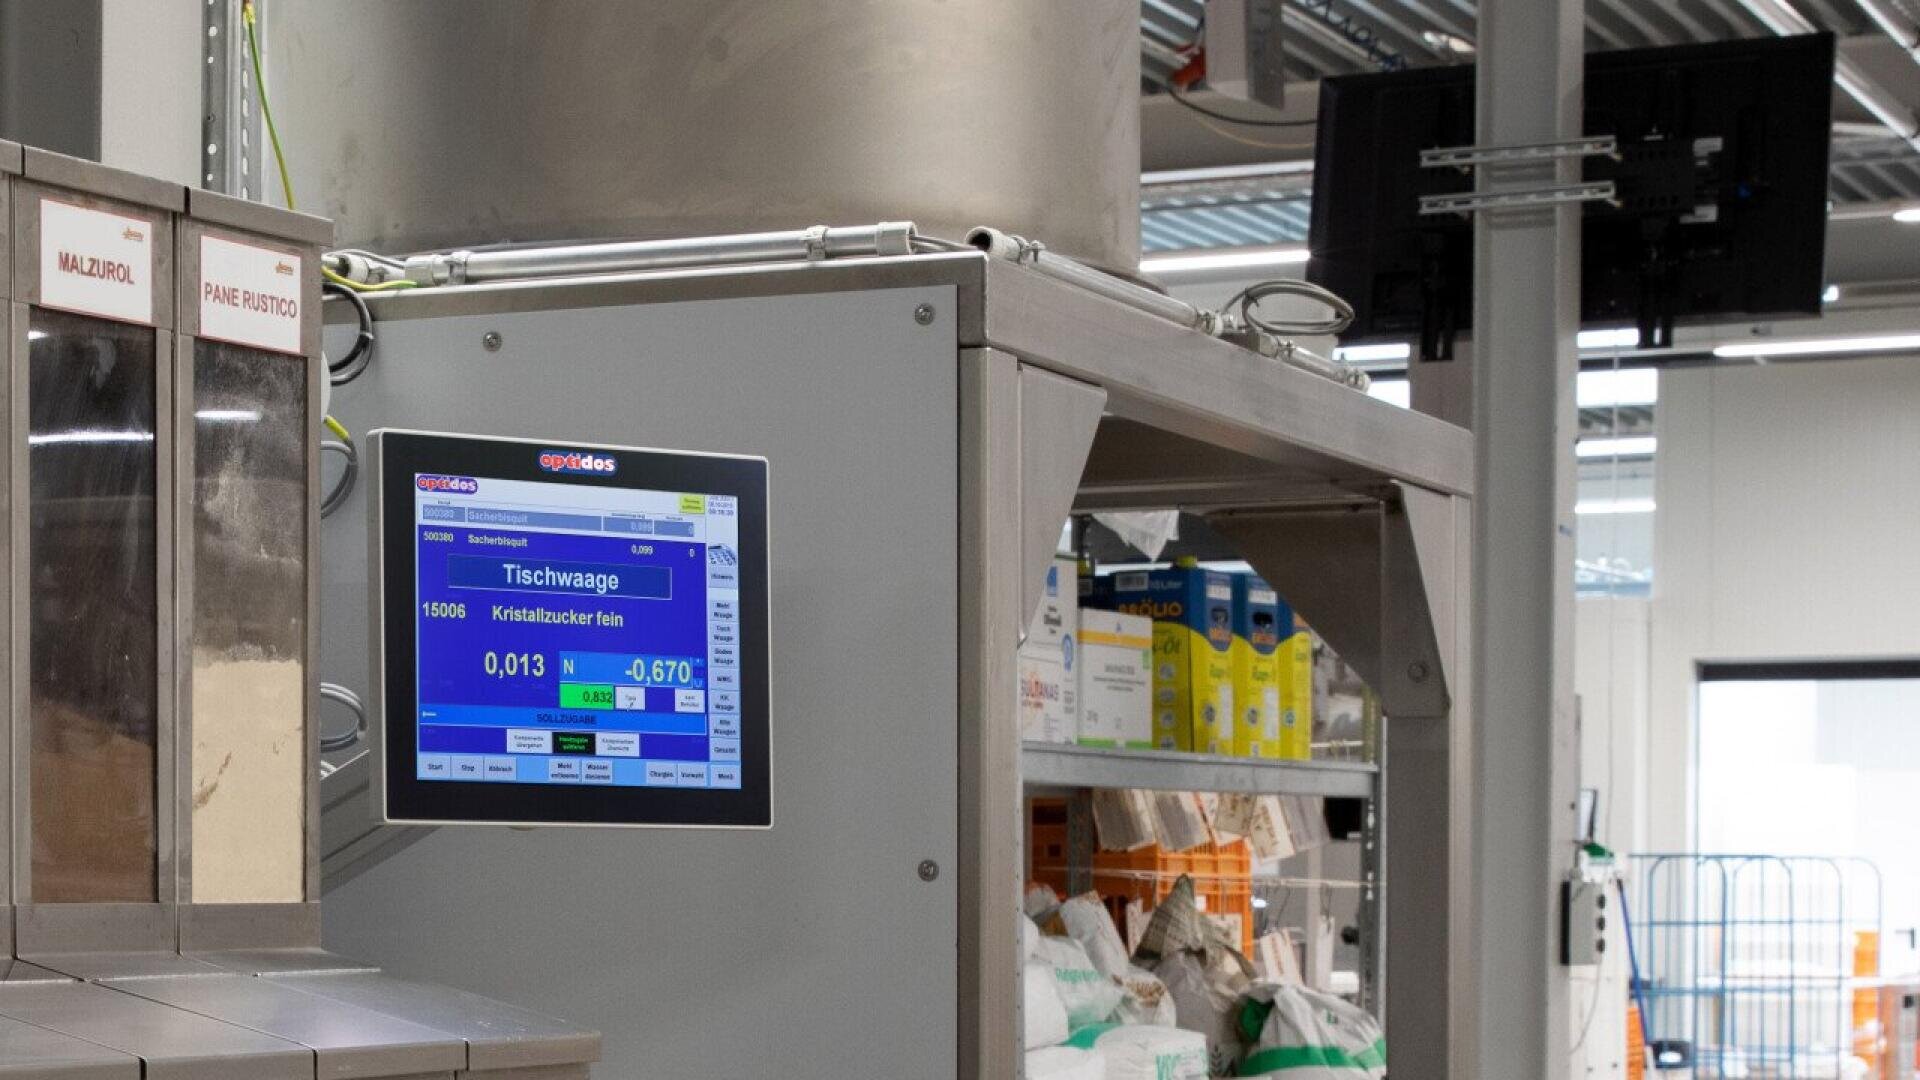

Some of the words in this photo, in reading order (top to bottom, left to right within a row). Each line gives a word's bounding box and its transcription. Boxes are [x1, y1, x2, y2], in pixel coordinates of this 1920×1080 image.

[58, 251, 135, 285] MALZUROL
[204, 281, 240, 307] PANE
[242, 290, 298, 319] RUSTICO
[539, 453, 616, 472] optidos
[417, 477, 477, 493] optidos
[467, 533, 528, 548] Sacherbisquit
[631, 543, 654, 556] 0,099
[502, 563, 619, 595] Tischwaage
[422, 601, 466, 619] 15006
[492, 604, 593, 625] Kristallzucker
[596, 610, 624, 628] fein
[484, 650, 546, 679] 0,013
[563, 658, 574, 675] N
[624, 657, 692, 685] -0,670
[583, 690, 613, 705] 0,832
[427, 762, 443, 770] Start
